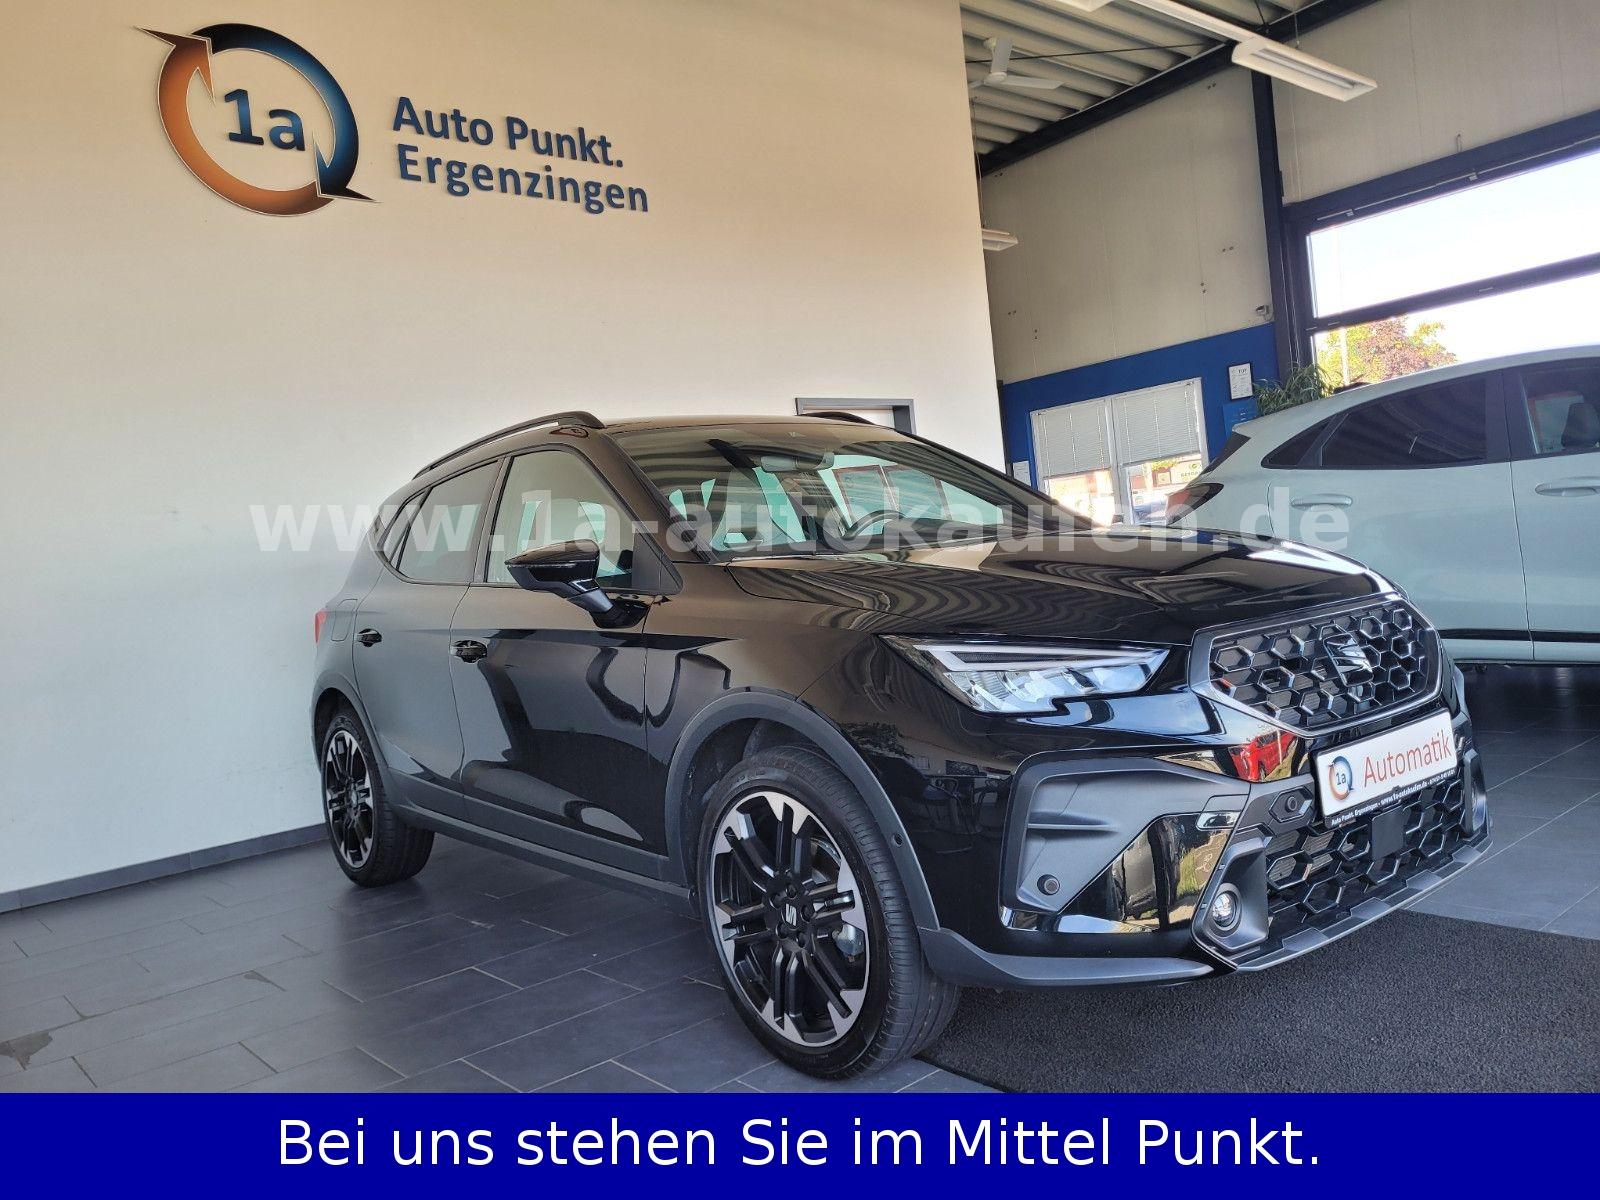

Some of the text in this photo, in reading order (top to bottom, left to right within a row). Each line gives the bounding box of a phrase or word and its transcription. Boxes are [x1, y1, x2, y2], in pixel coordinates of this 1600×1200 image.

[224, 89, 305, 152] 1a
[393, 97, 624, 168] Auto Punkt.
[398, 144, 648, 214] Ergenzingen
[1335, 772, 1347, 786] 1a
[1363, 729, 1452, 788] Automatik
